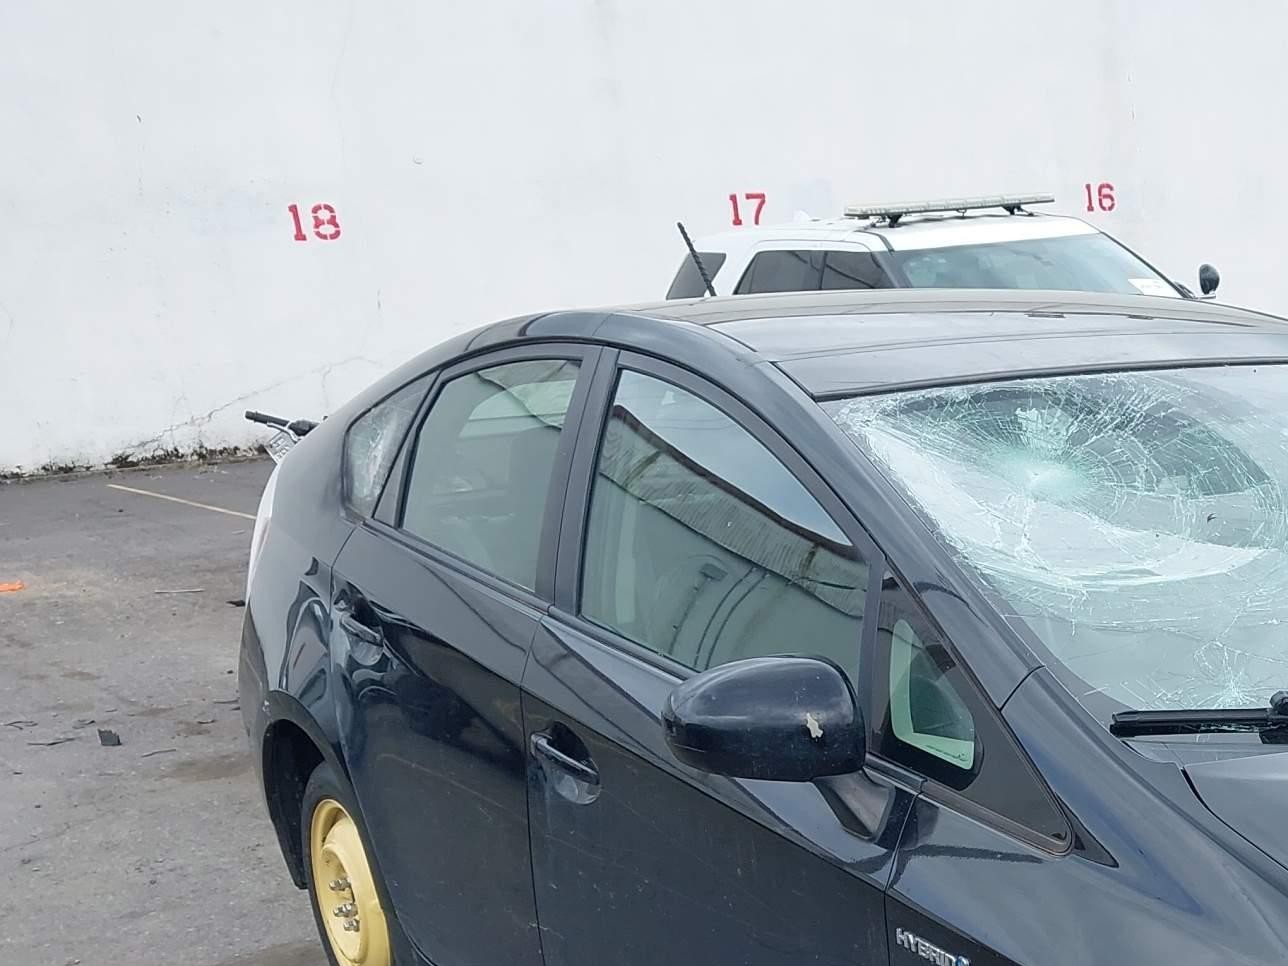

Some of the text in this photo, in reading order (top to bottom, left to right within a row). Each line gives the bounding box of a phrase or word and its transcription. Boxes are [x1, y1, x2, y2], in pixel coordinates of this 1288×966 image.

[729, 192, 766, 226] 17
[1085, 183, 1115, 212] 16
[288, 203, 341, 241] 18
